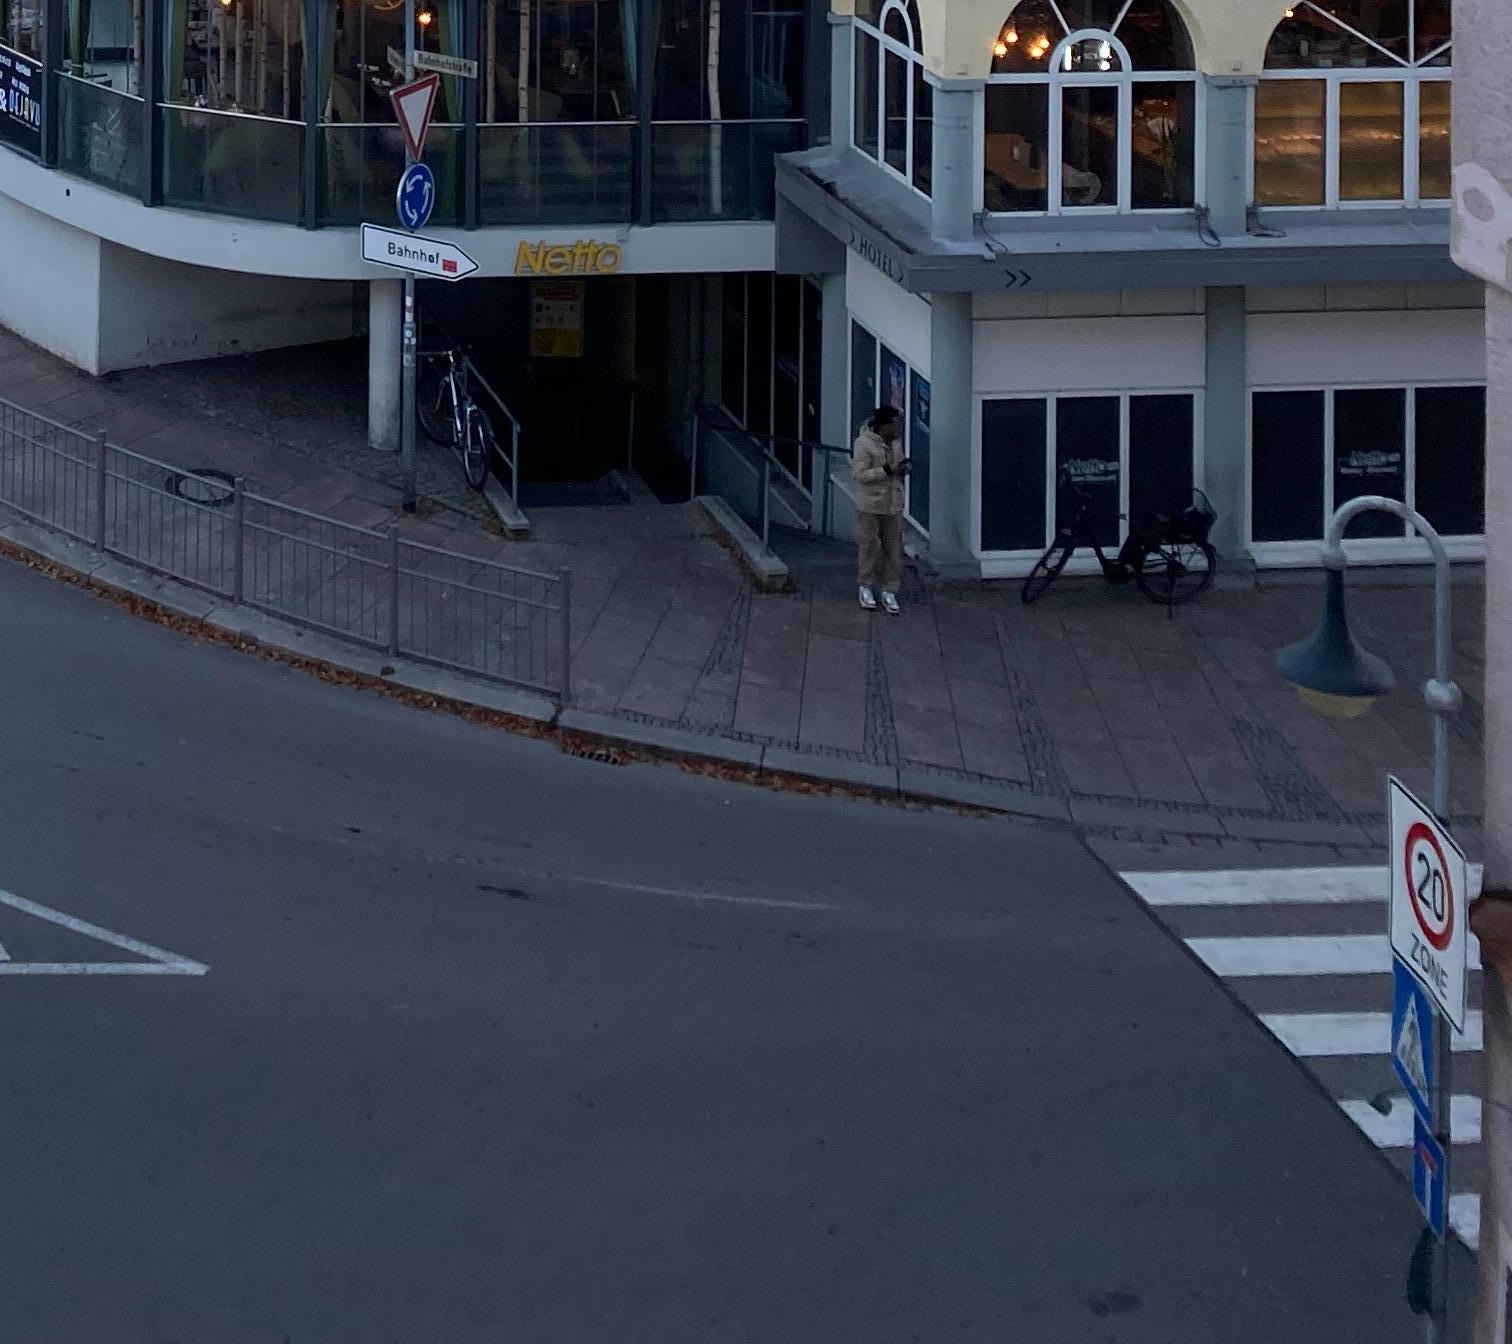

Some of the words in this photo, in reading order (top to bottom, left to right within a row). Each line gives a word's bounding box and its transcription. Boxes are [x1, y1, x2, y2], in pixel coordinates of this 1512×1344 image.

[387, 242, 440, 265] Bahnhof
[515, 239, 622, 276] Netto
[859, 236, 893, 278] HOTEL
[1417, 852, 1445, 922] 20
[1409, 932, 1449, 1001] ZONE
